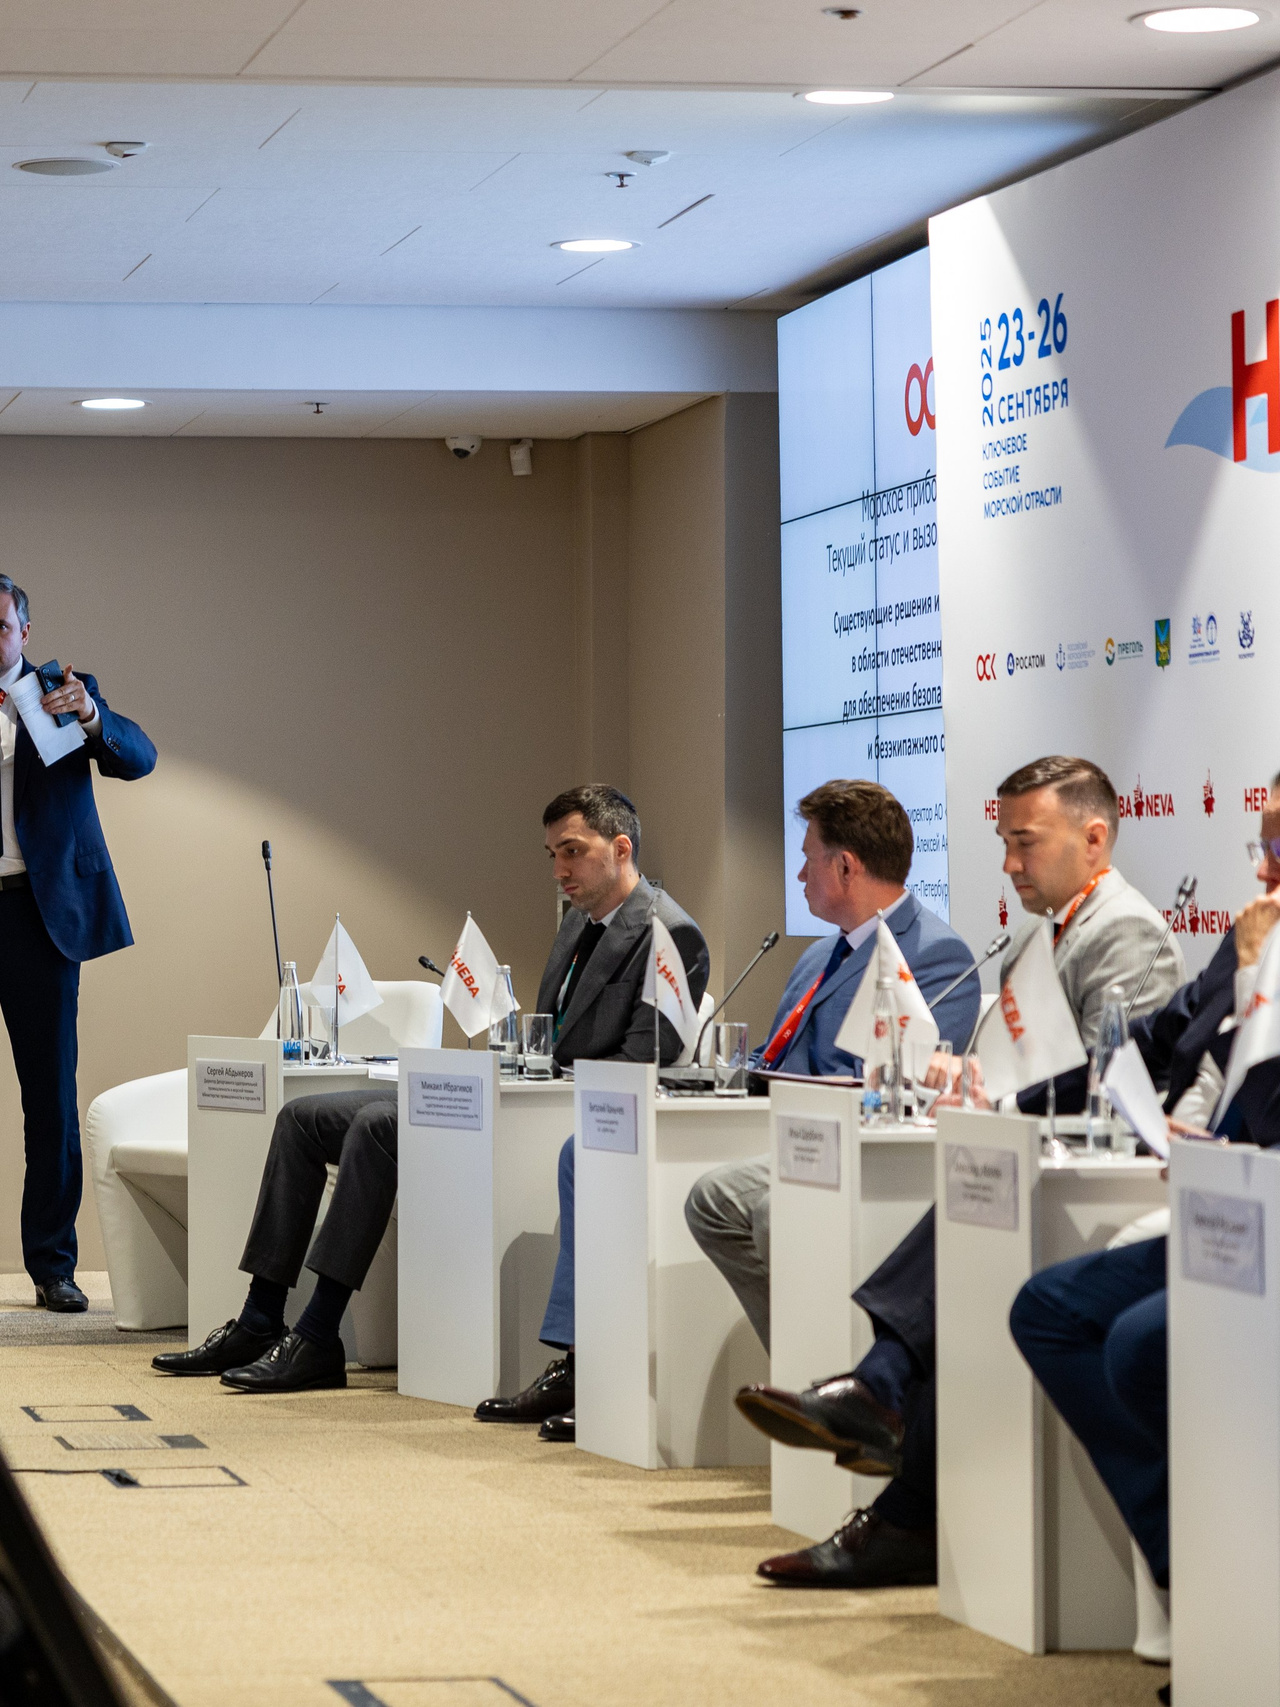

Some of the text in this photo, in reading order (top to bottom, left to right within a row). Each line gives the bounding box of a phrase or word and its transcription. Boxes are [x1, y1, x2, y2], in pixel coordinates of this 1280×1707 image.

[998, 292, 1068, 370] 23-26
[980, 318, 994, 427] 2025
[998, 378, 1068, 424] СЕНТЯБРЯ
[982, 433, 1027, 460] КЛЮЧЕВОЕ
[983, 465, 1020, 490] СОБЫТИЕ
[862, 468, 937, 526] Морское прибо
[984, 486, 1062, 519] МОРСКОЙ ОТРАСЛИ
[826, 522, 938, 576] Текущий статус и вызо
[834, 594, 940, 638] Существующие решения и
[852, 640, 942, 673] в области отечественн
[976, 653, 997, 681] ОСК
[1016, 654, 1046, 670] РОСАТОМ
[843, 682, 941, 725] для обеспечения безопа
[868, 743, 872, 760] и
[874, 735, 938, 760] безэкипажного
[934, 803, 943, 821] АО
[985, 800, 1000, 820] НЕ
[1118, 796, 1133, 818] ВА
[1146, 793, 1174, 817] NEVA
[1244, 787, 1268, 812] НЕВ
[916, 833, 940, 852] Алексей
[1202, 911, 1231, 934] NEVA
[451, 958, 479, 998] НЕВА
[207, 1066, 224, 1076] Сергей
